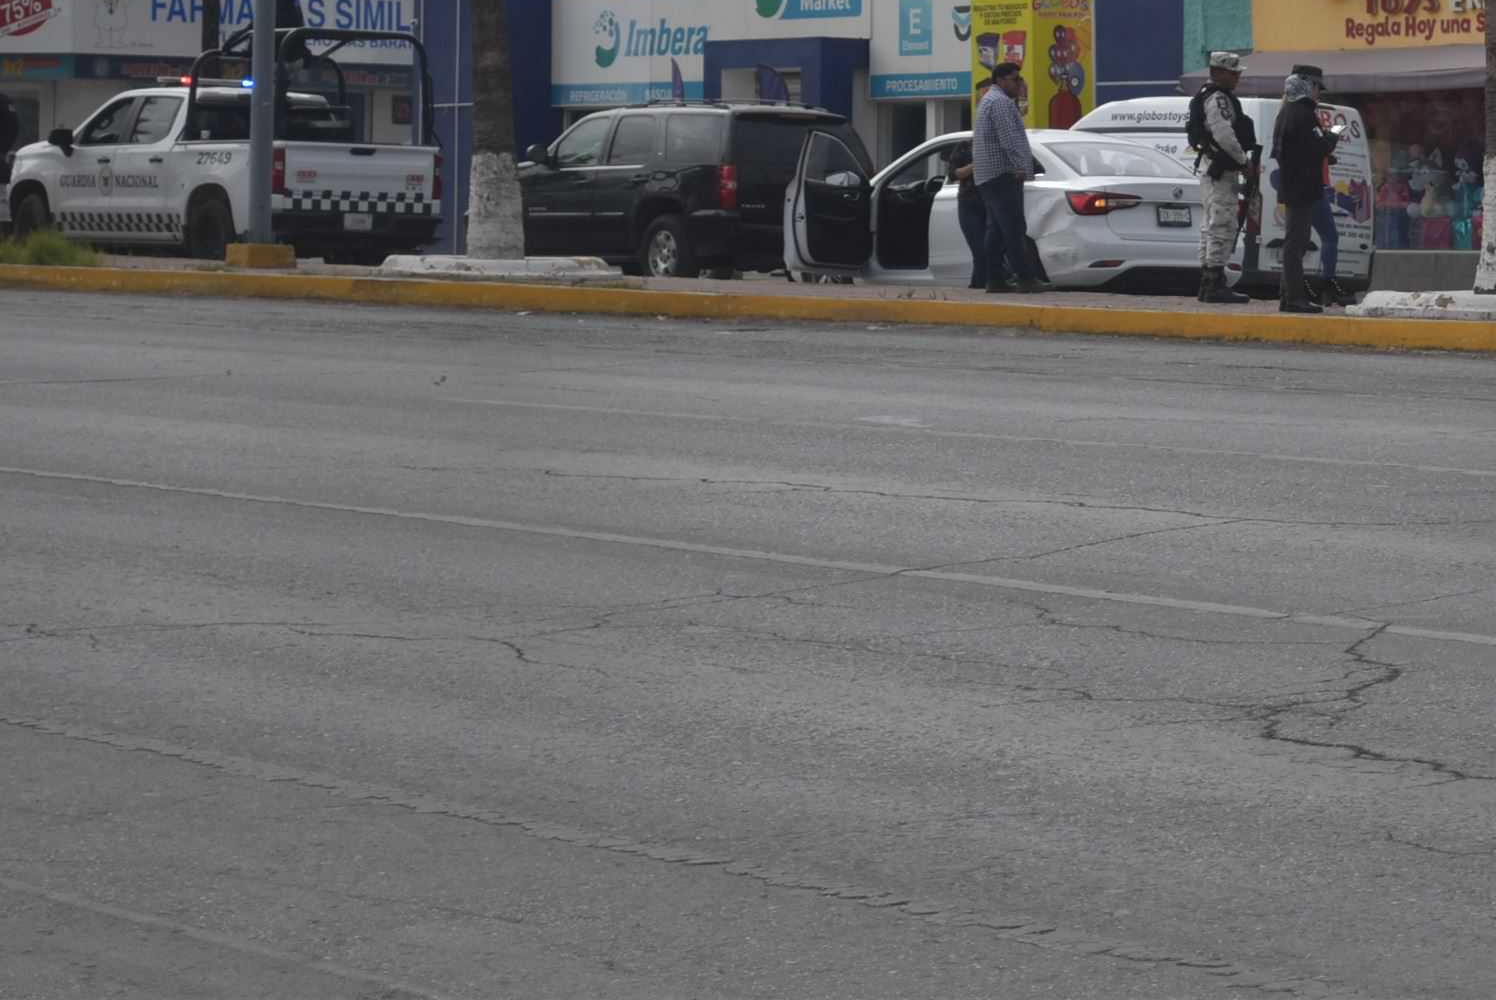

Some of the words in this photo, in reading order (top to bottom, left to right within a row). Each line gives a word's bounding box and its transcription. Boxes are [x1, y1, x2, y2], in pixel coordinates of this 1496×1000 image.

[909, 7, 921, 35] E
[1345, 16, 1400, 45] Regala
[1404, 15, 1437, 40] Hoy
[1441, 17, 1471, 33] una
[624, 18, 707, 57] Imbera
[885, 77, 959, 91] PROCESAMIENTO
[196, 152, 232, 166] 27649
[60, 174, 97, 188] GUARDIA
[115, 175, 159, 189] NACIONAL
